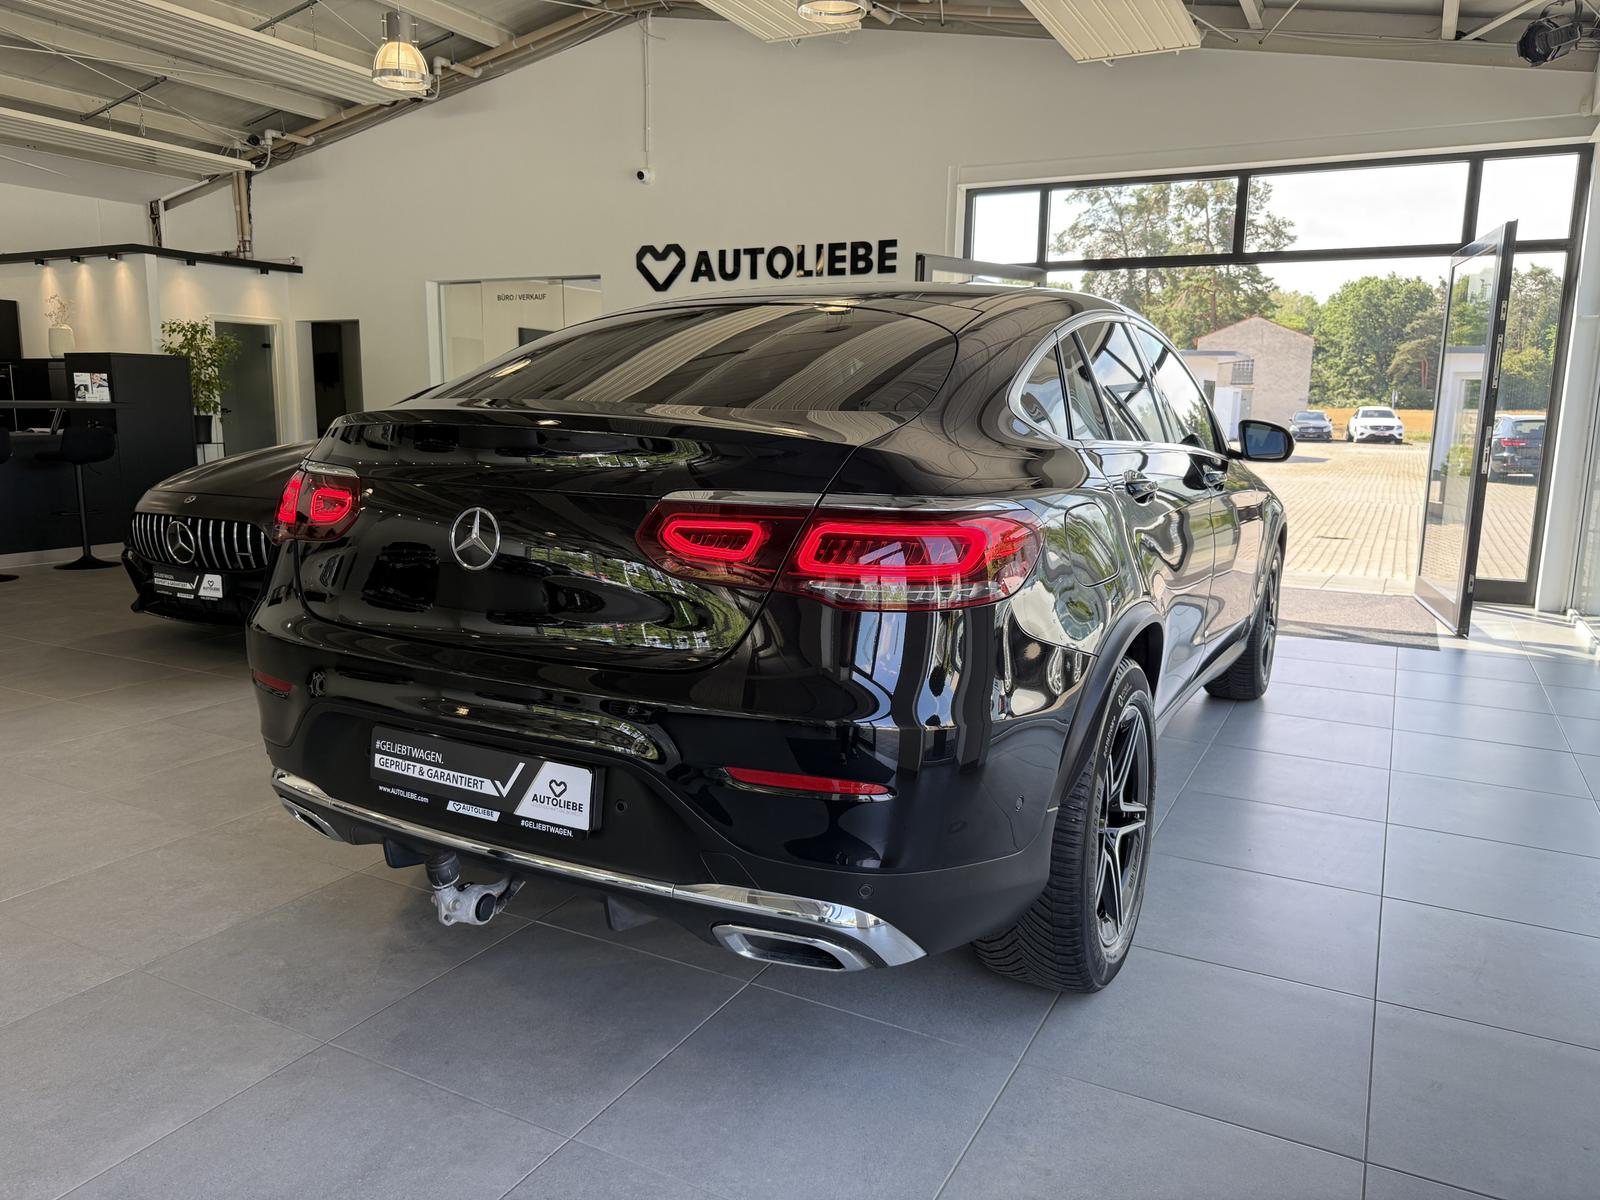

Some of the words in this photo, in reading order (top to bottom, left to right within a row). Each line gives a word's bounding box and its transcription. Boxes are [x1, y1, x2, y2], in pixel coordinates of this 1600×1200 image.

[690, 239, 898, 283] AUTOLIEBE
[497, 293, 513, 301] BÜRO
[518, 293, 547, 301] VERKAUF
[375, 739, 444, 764] #GELIEBTWAGEN.
[378, 757, 417, 775] GEPRÜFT
[418, 766, 425, 777] &
[426, 768, 485, 790] GARANTIERT
[461, 804, 495, 818] AUTOLIEBE
[531, 793, 584, 813] AUTOLIEBE
[520, 819, 574, 838] #GELIEBTWAGEN.
